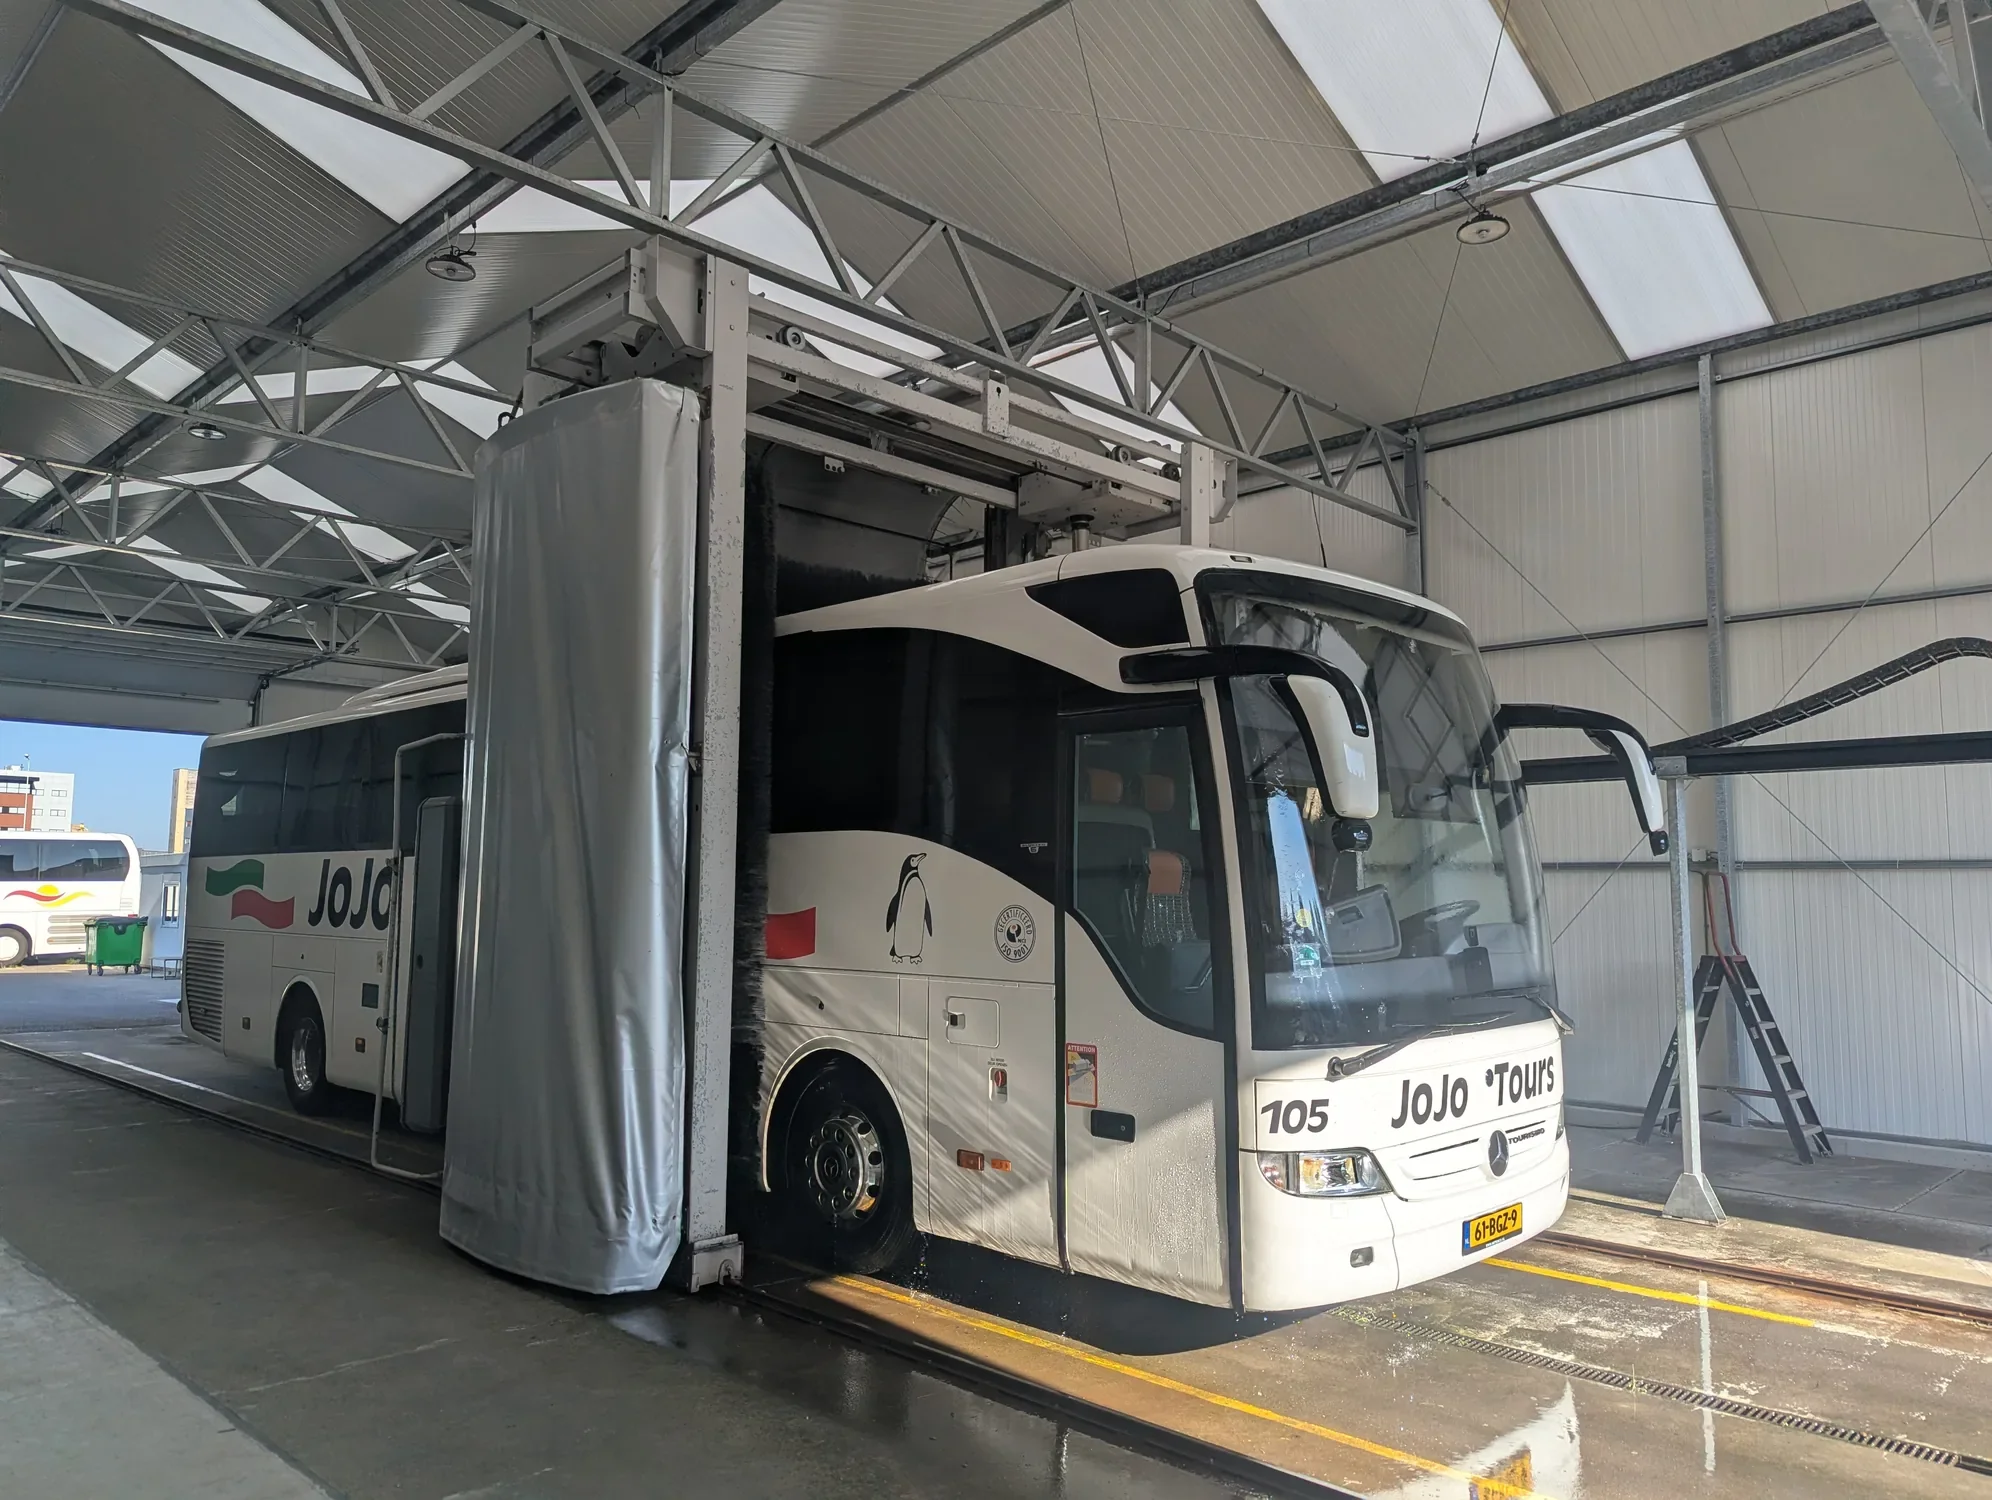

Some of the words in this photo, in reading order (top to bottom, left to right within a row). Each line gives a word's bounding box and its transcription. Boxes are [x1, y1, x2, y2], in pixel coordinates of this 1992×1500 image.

[998, 909, 1032, 935] GECERTIFICEERD
[1001, 943, 1012, 956] ISO
[1014, 944, 1028, 958] 9001
[1067, 1045, 1096, 1053] ATTENTION
[1391, 1074, 1468, 1129] JoJo
[1494, 1056, 1554, 1106] Tours
[1261, 1099, 1329, 1134] 105
[1475, 1209, 1517, 1241] 61-BGZ-9
